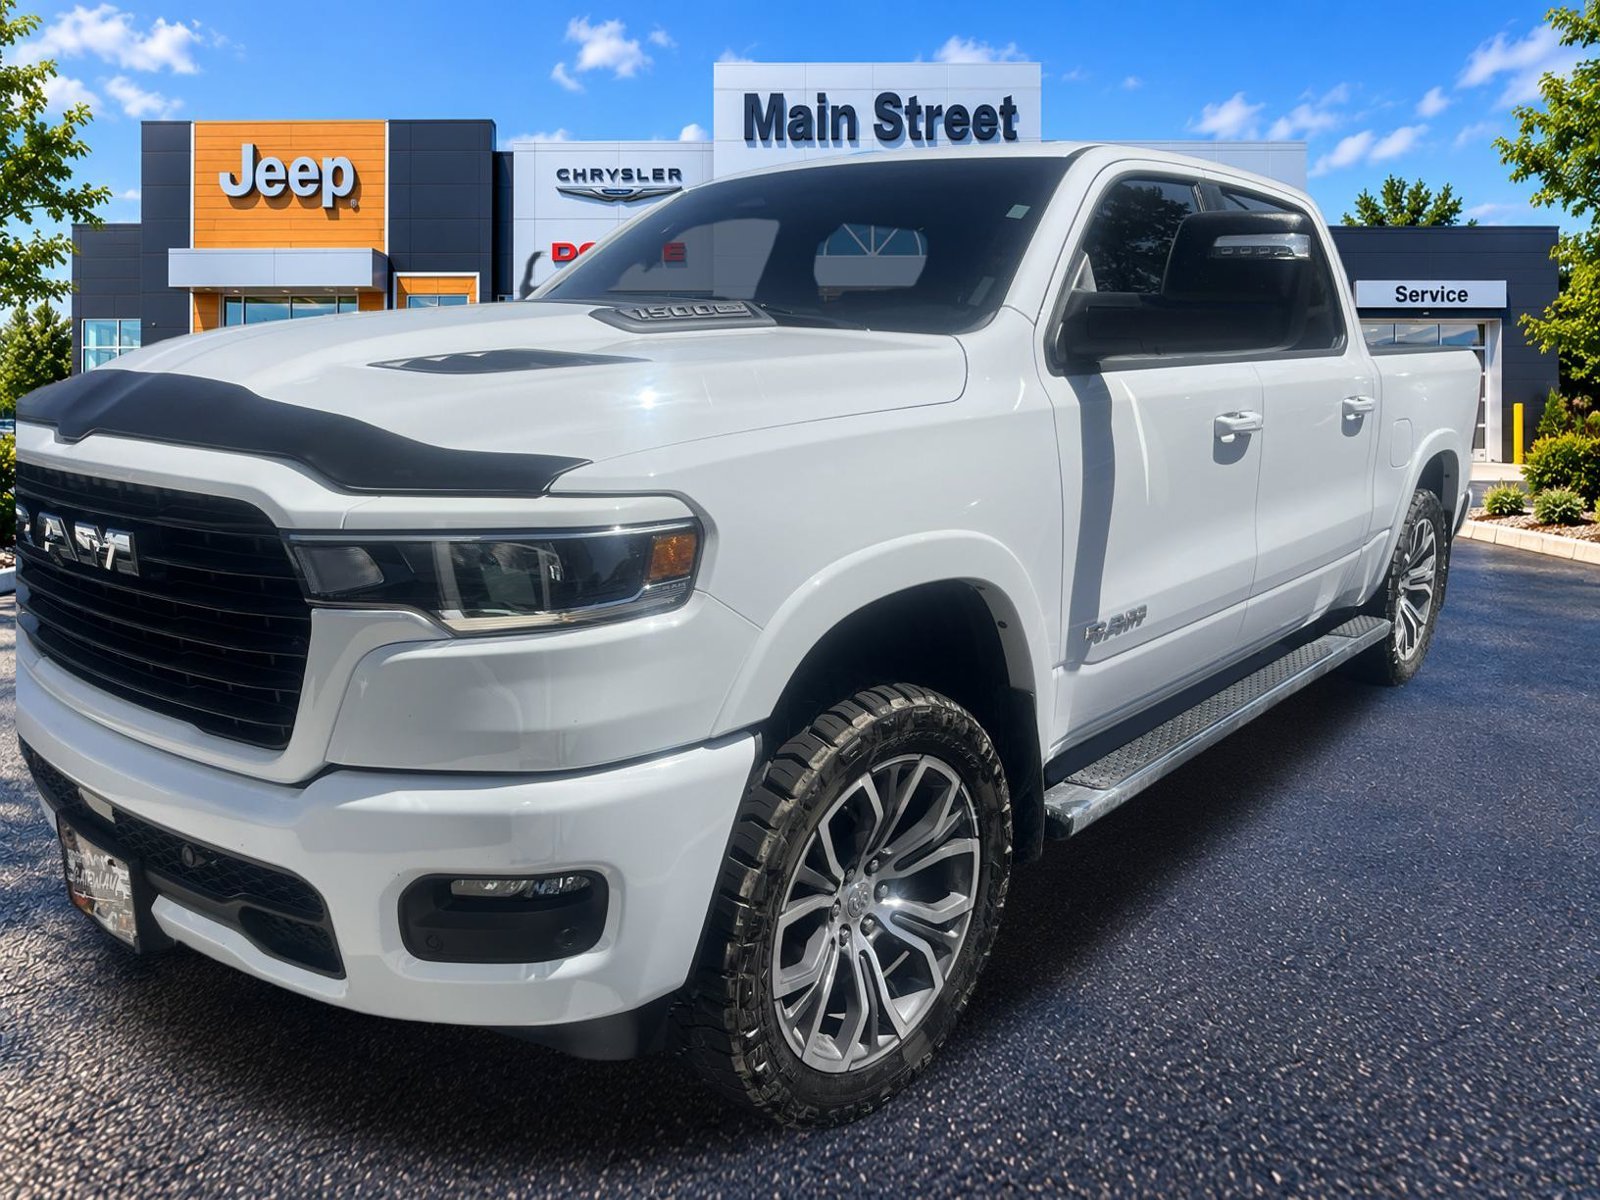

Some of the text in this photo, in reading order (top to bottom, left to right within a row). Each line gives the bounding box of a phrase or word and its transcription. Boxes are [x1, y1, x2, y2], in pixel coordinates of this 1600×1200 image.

[744, 91, 1018, 142] Main Street
[219, 143, 355, 208] Jeep
[556, 168, 683, 182] CHRYSLER
[1395, 285, 1469, 303] Service
[635, 304, 714, 319] 1500
[1084, 605, 1147, 645] RAM
